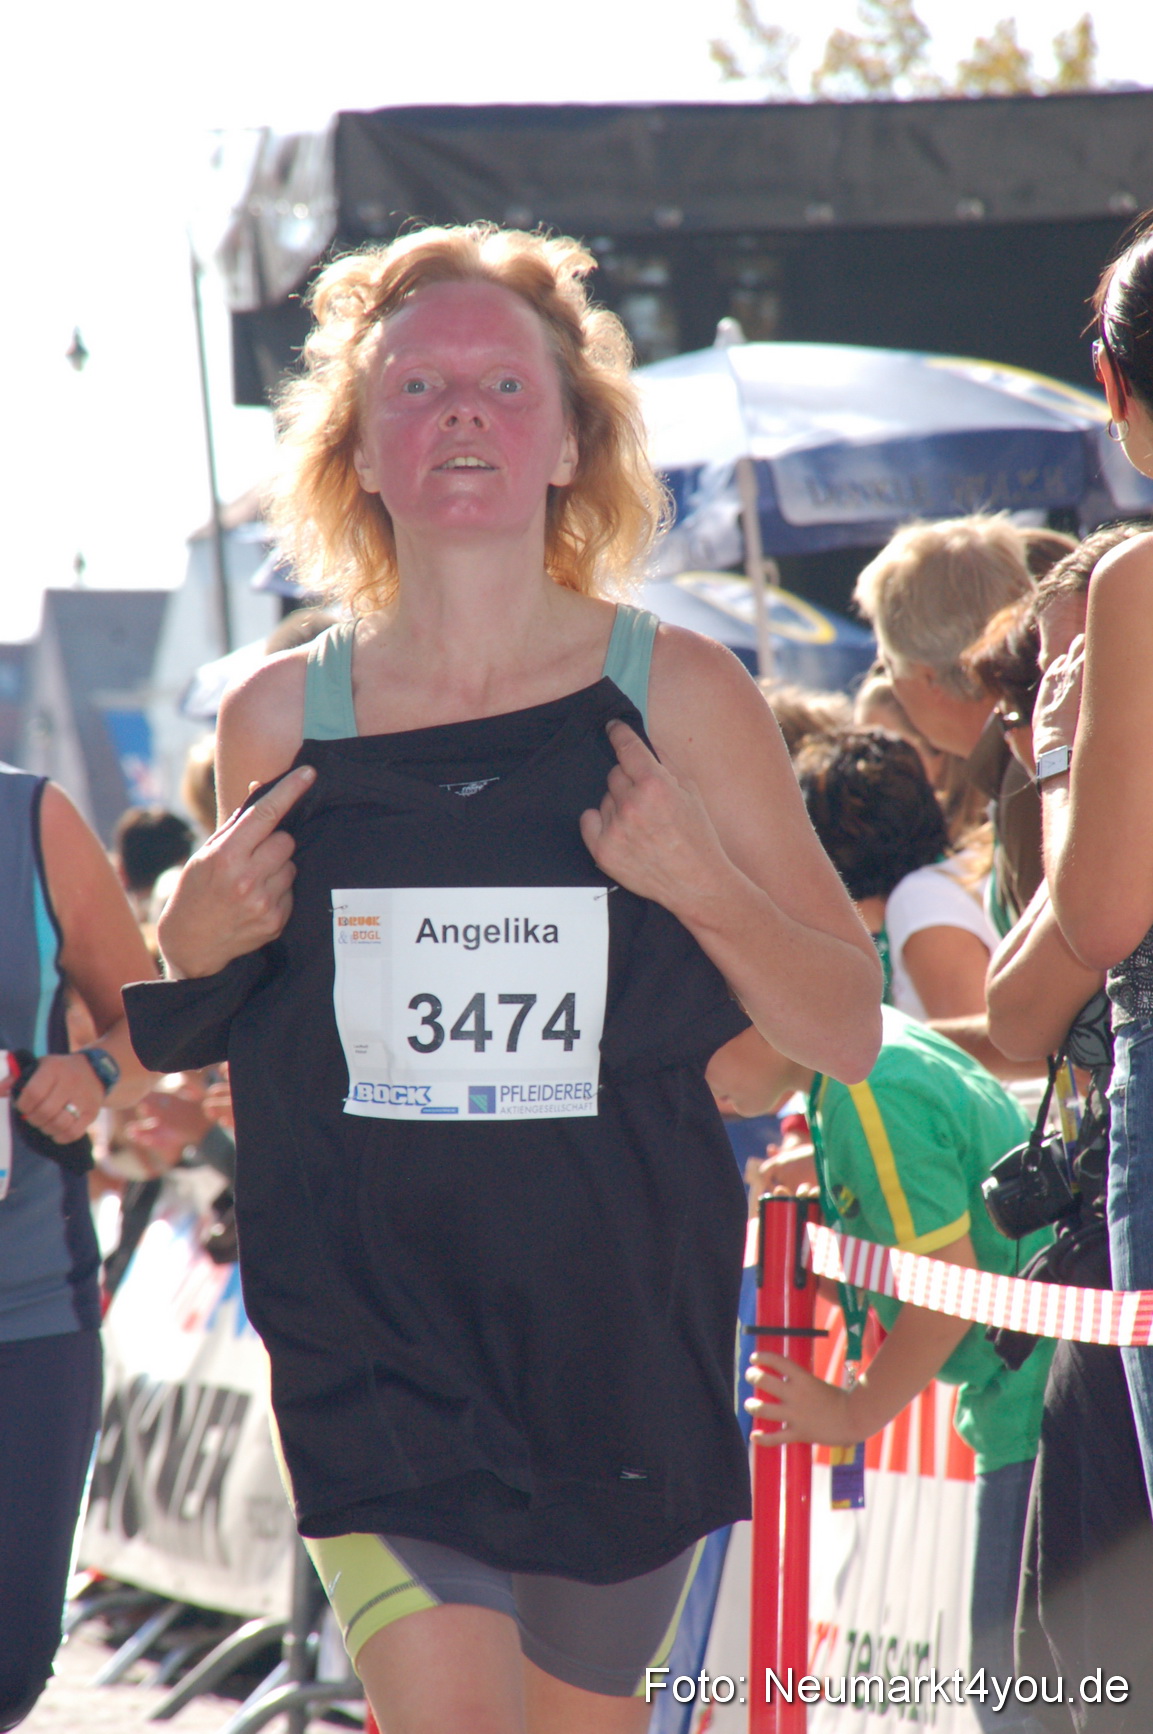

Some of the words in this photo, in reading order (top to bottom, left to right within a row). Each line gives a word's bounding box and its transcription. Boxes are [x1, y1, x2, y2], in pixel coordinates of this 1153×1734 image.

[337, 916, 381, 927] DRUCK
[415, 917, 559, 950] Angelika
[406, 992, 581, 1054] 3474
[353, 1082, 432, 1106] BOCK
[500, 1082, 593, 1102] PFLEIDERER
[499, 1102, 593, 1115] AKTIENGESELLSCHAFT
